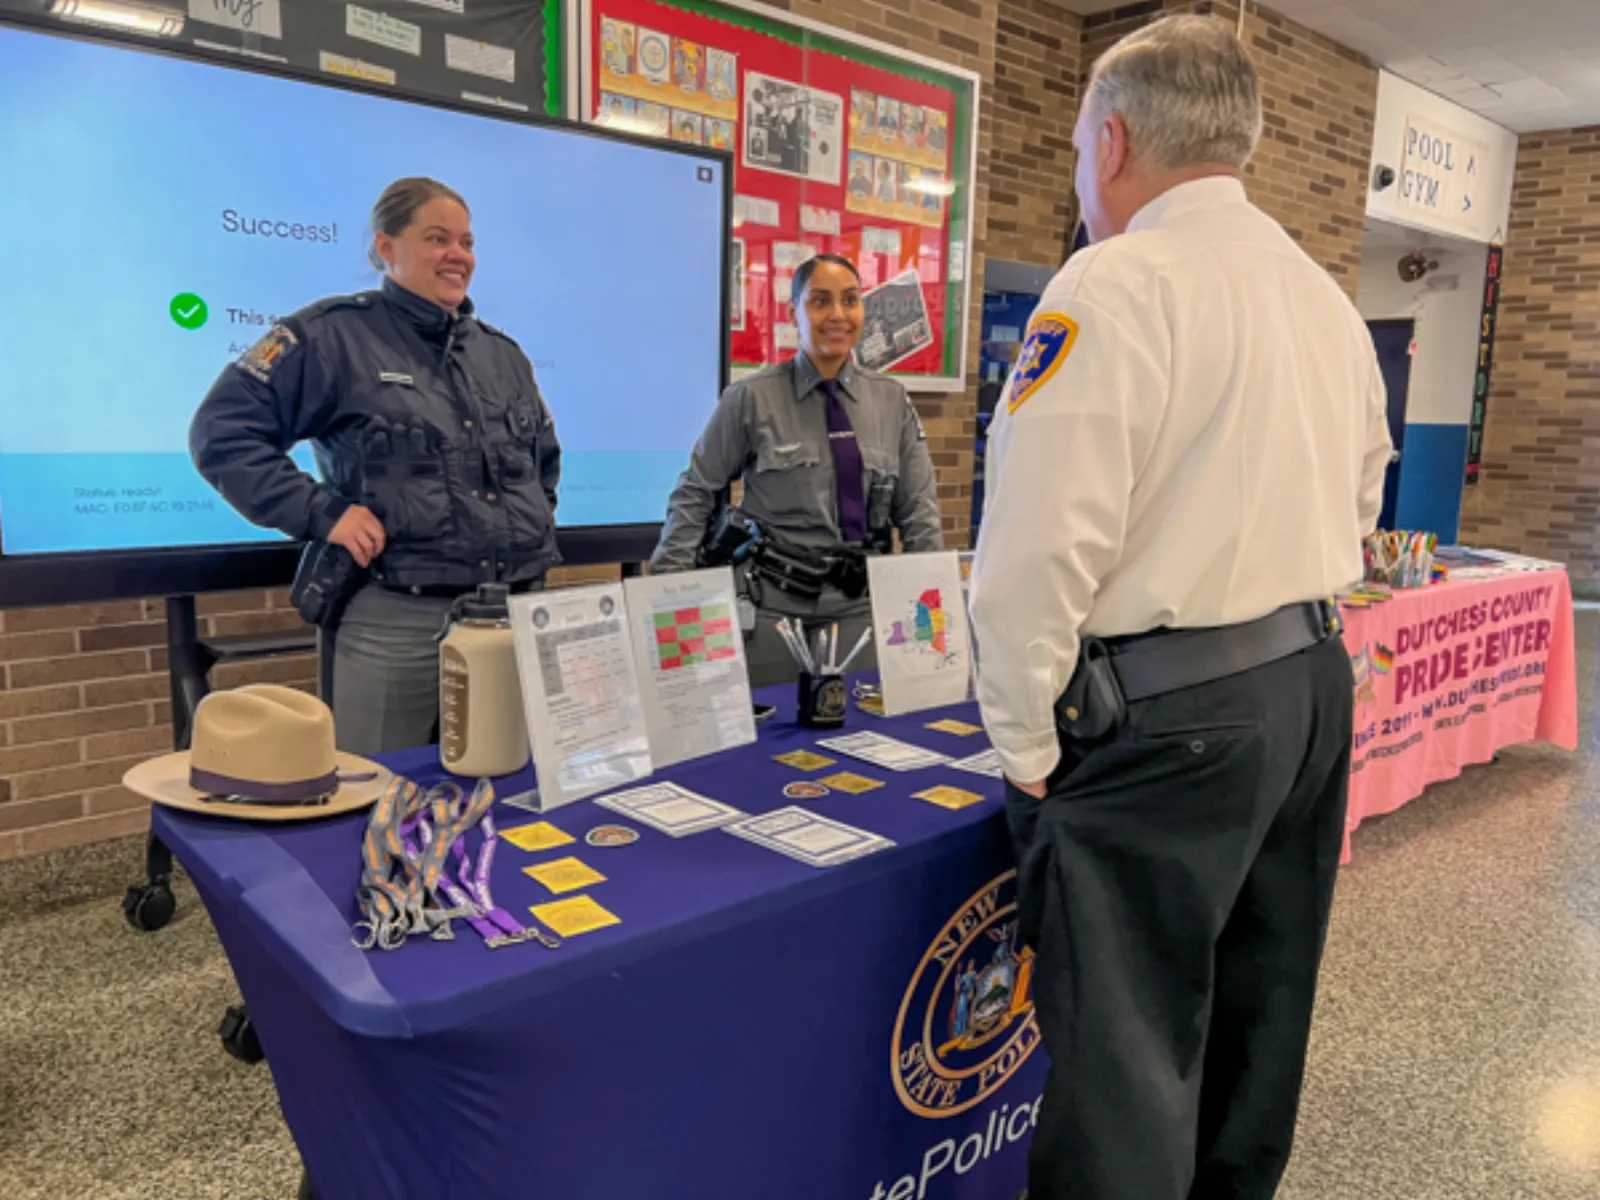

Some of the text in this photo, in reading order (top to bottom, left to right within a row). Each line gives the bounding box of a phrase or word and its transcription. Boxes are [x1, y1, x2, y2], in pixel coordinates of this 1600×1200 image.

[1408, 127, 1453, 171] POOL
[1402, 169, 1440, 208] GYM
[222, 209, 338, 243] Success!
[226, 308, 264, 325] This
[1397, 585, 1553, 656] DUTCHESS COUNTY
[1395, 643, 1469, 705] PRIDE
[930, 888, 999, 967] NEW
[900, 1042, 962, 1108] STATE
